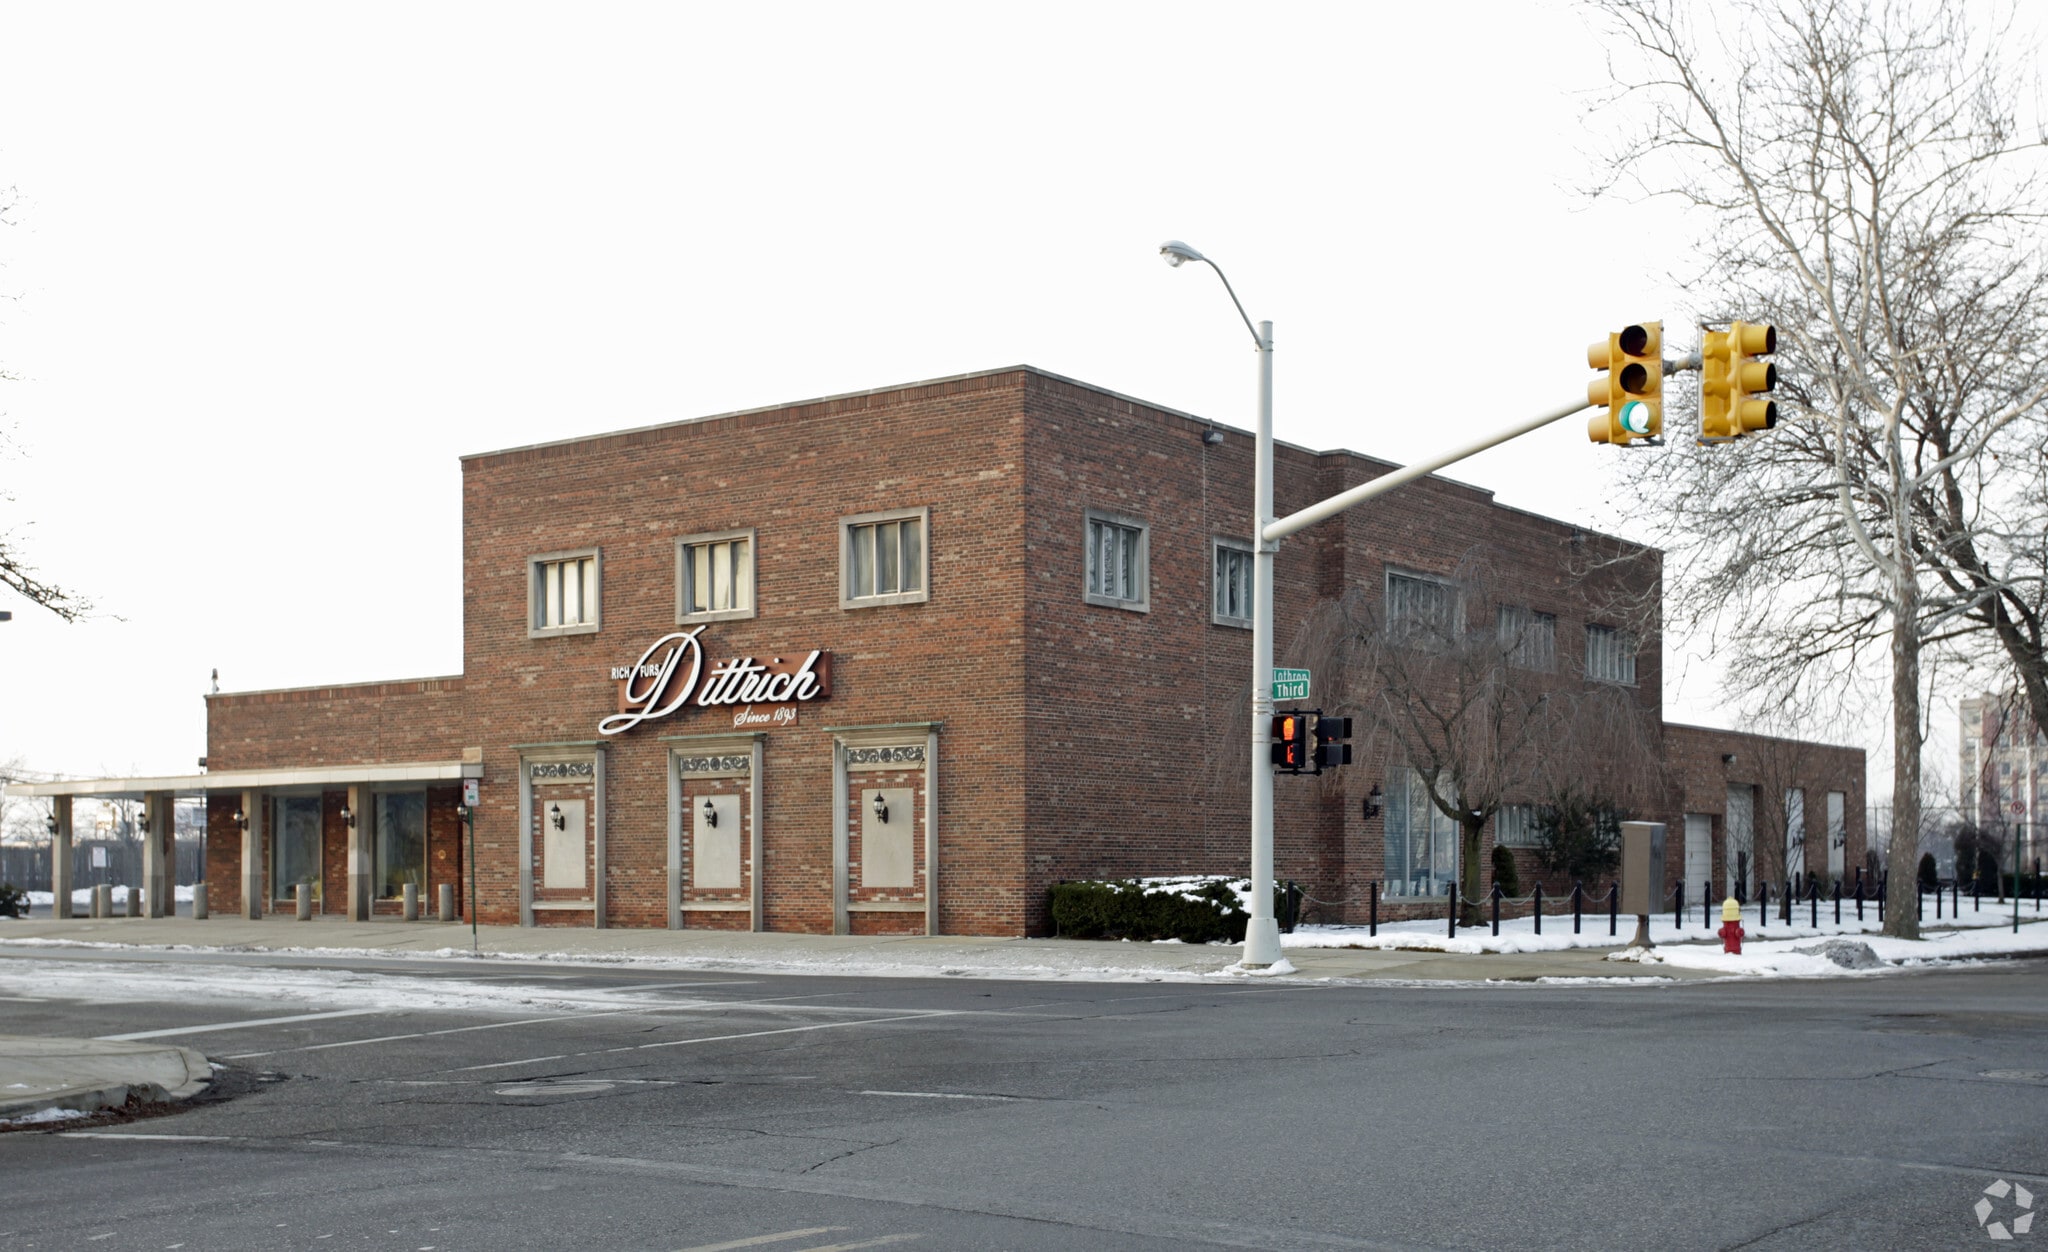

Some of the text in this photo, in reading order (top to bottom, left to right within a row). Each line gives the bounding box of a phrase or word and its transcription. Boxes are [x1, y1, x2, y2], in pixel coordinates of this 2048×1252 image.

[598, 625, 821, 735] Dittrich
[611, 664, 660, 680] RICH FURS
[1277, 682, 1304, 697] Third
[733, 704, 797, 728] Since 1893
